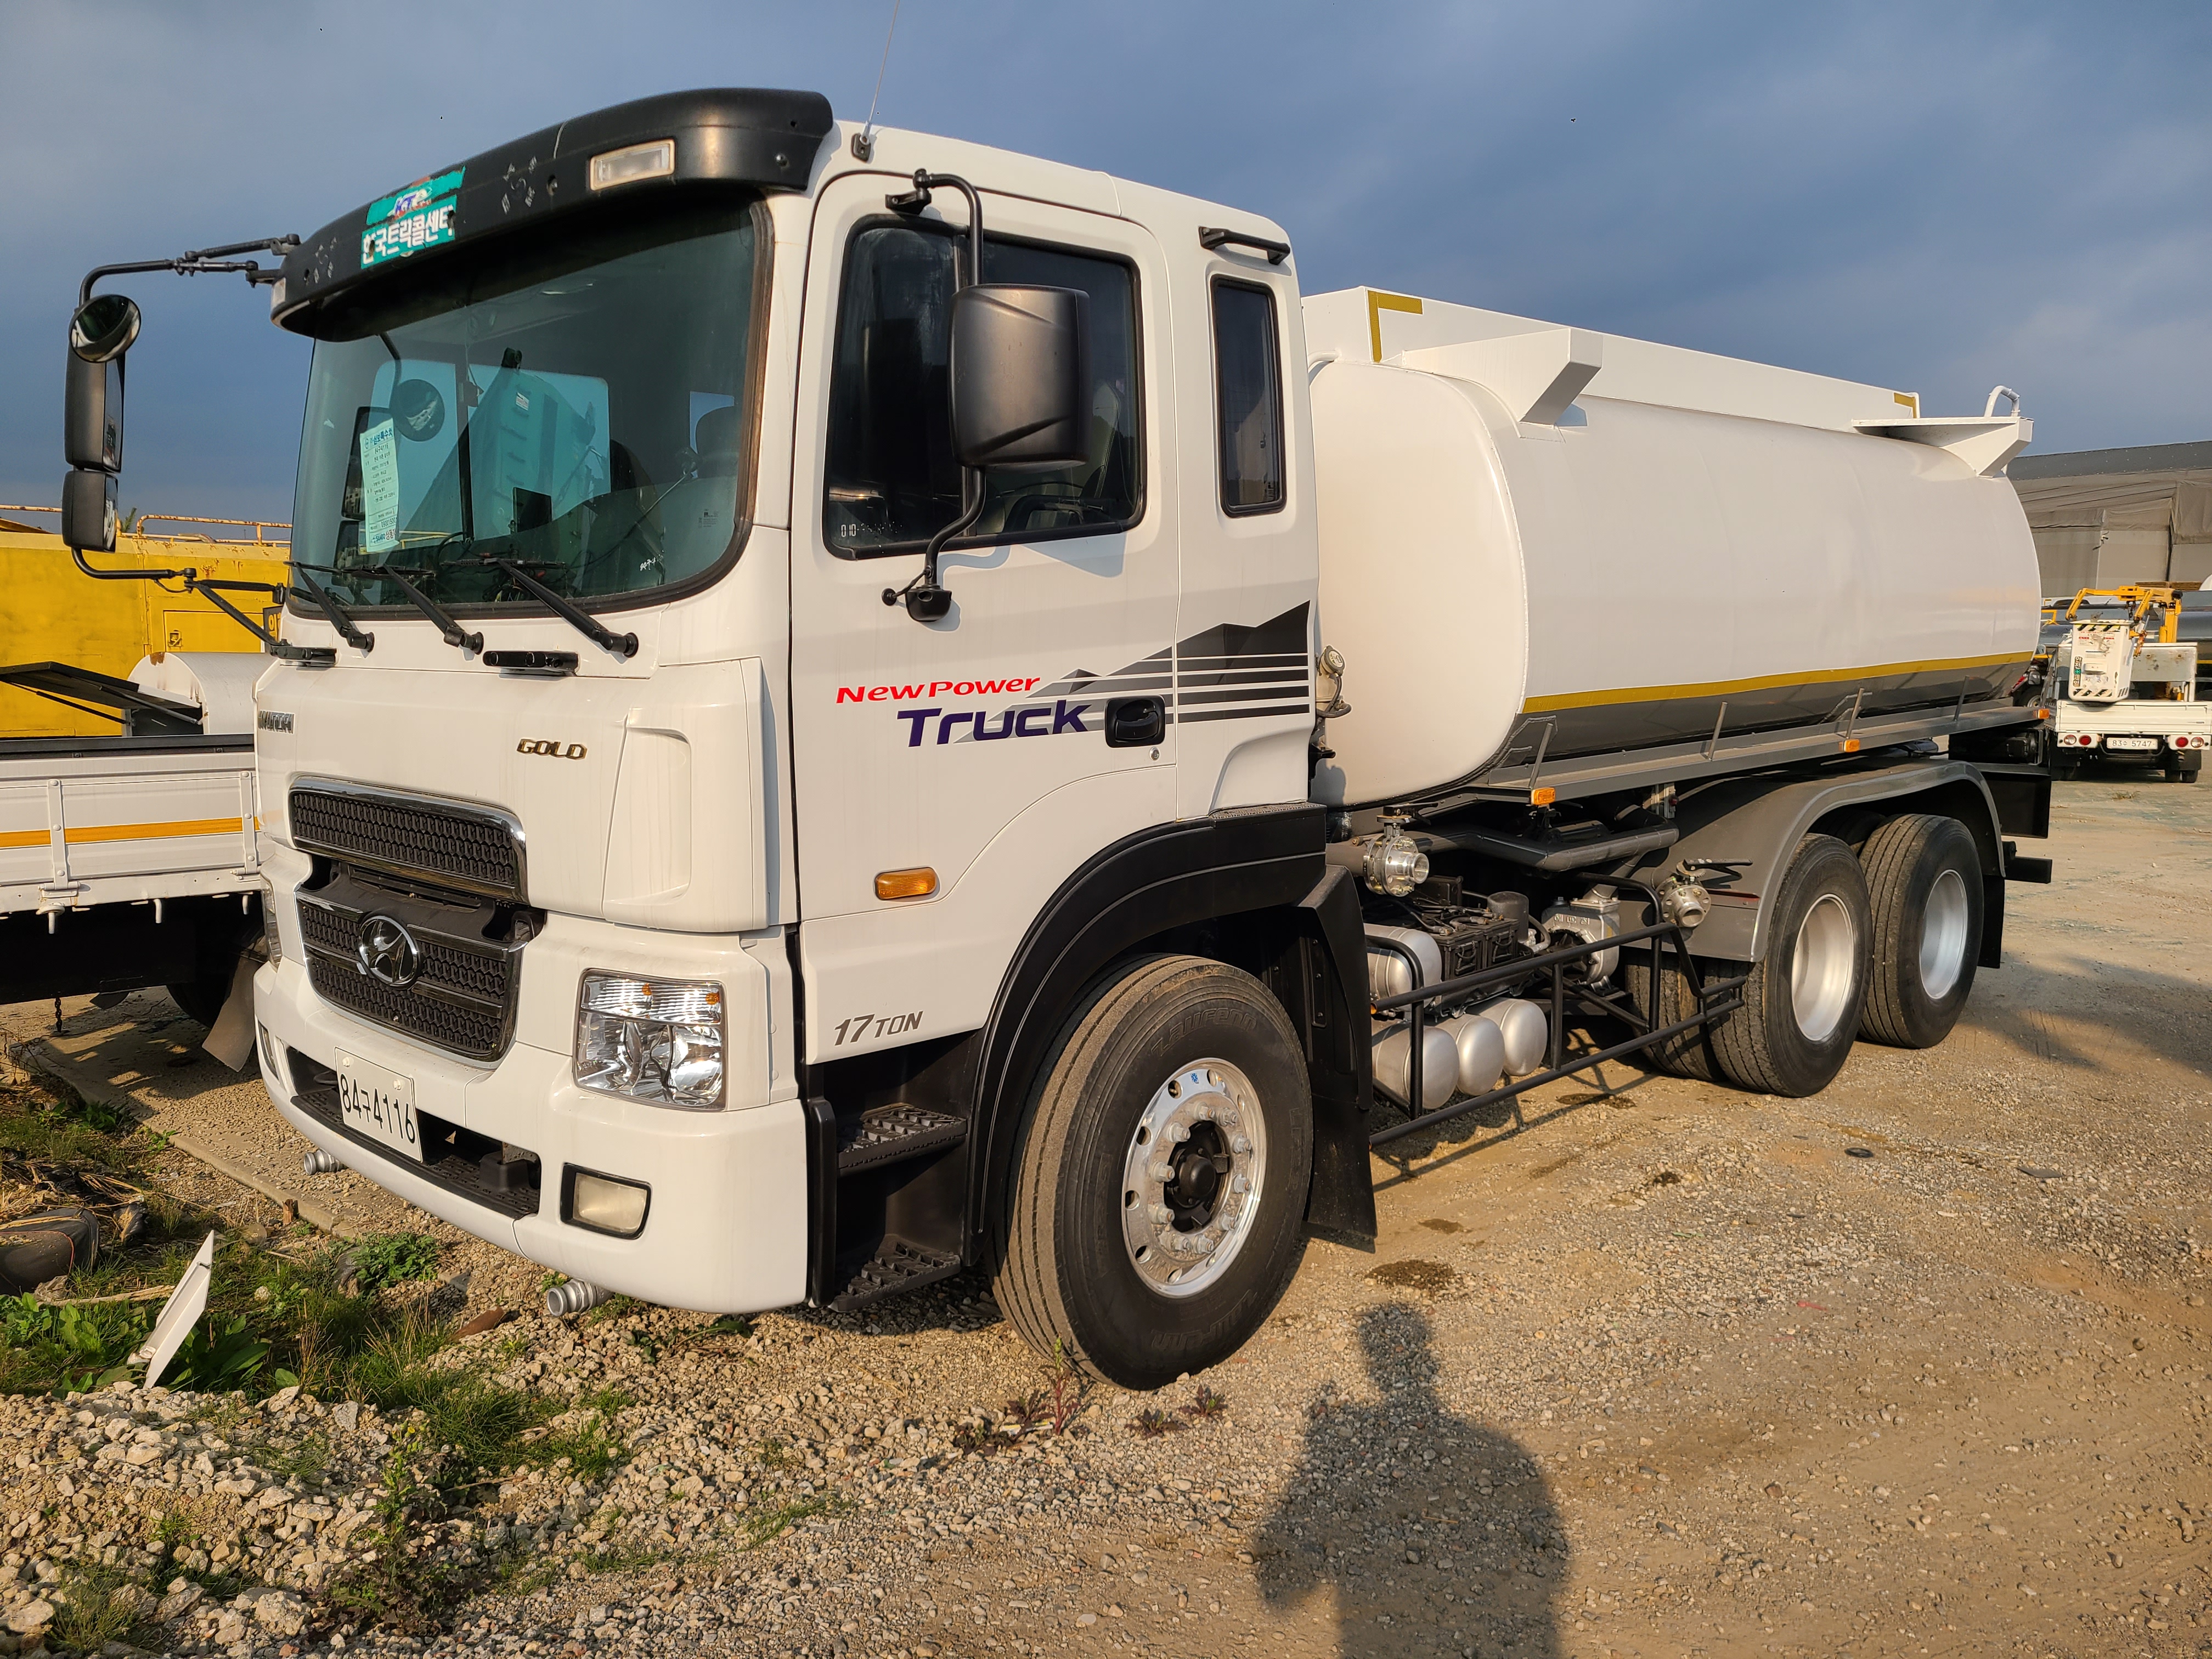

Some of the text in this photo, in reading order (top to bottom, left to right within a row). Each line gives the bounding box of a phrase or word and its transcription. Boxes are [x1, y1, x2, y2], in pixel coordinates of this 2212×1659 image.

[836, 676, 1041, 703] New Power
[897, 699, 1092, 747] Truck
[517, 738, 587, 760] GOLD
[834, 1011, 923, 1046] 17 TON
[340, 1074, 415, 1144] 84구4116
